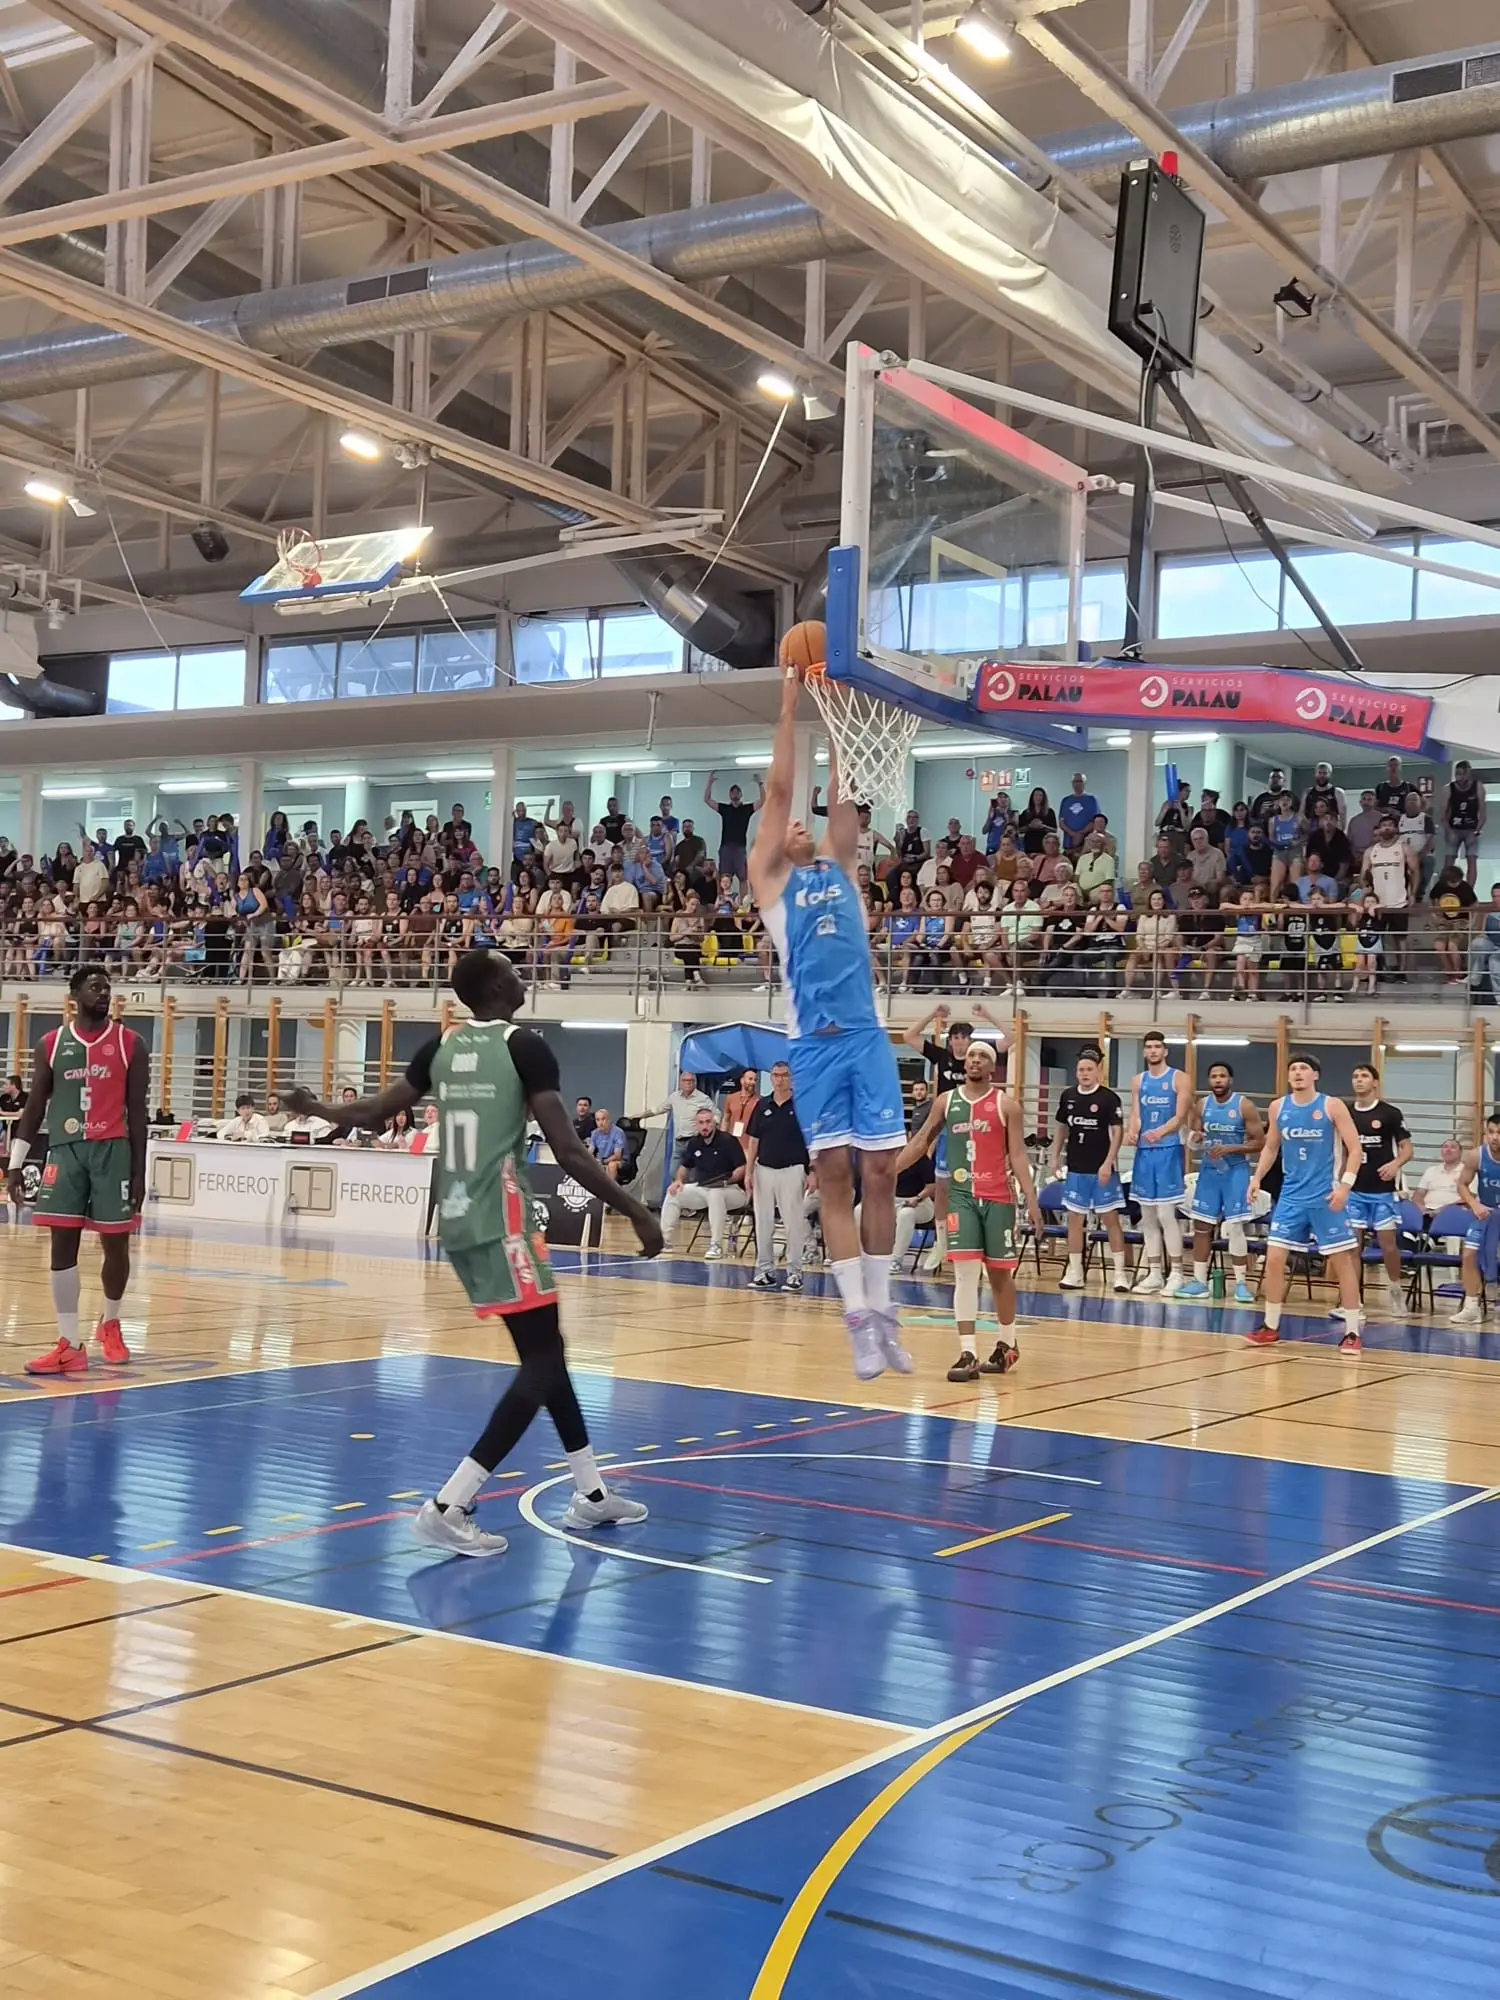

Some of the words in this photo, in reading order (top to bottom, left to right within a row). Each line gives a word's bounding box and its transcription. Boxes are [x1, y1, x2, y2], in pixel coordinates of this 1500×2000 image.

[1019, 672, 1085, 683] SERVICIOS
[1171, 677, 1242, 688] SERVICIOS
[1018, 684, 1083, 702] PALAU
[1171, 689, 1241, 709] PALAU
[1332, 692, 1408, 713] SERVICIOS
[1328, 704, 1404, 733] PALAU
[80, 1086, 92, 1112] 5
[198, 1172, 279, 1196] FERREROT
[340, 1182, 431, 1205] FERREROT
[970, 1777, 1232, 1896] MOTOR
